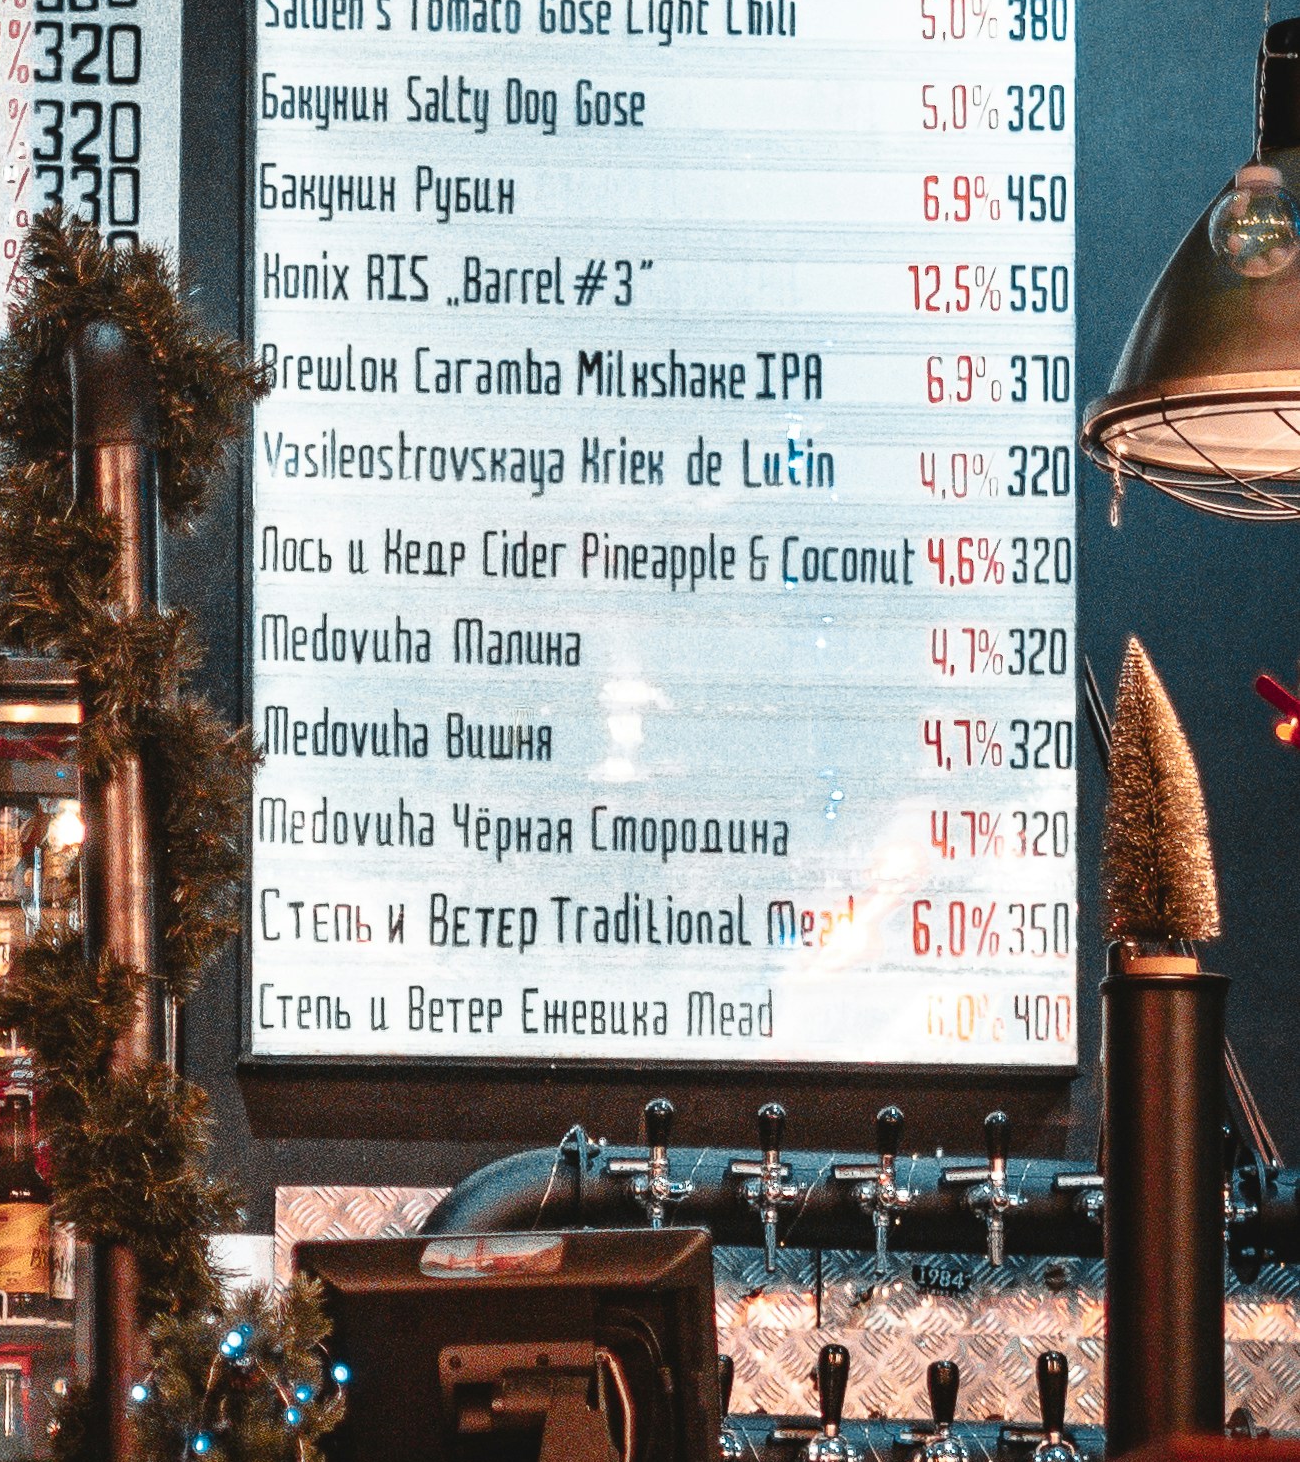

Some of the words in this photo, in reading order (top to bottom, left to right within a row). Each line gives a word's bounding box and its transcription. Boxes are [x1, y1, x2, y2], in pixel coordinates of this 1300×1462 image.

[33, 20, 142, 86] 320
[33, 99, 142, 164] 320
[262, 75, 388, 131] Бакунин
[407, 75, 489, 134] Salty
[505, 78, 558, 136] Dog
[575, 79, 646, 128] Gose
[1006, 83, 1064, 133] 320
[262, 164, 396, 222] Бакунин
[415, 165, 515, 224] Рубин
[1007, 174, 1065, 222] 450
[266, 250, 349, 301] Konix
[367, 253, 429, 303] RIS
[1010, 264, 1066, 313] 550
[415, 346, 562, 396] Caramba
[577, 348, 746, 400] Milkshake
[756, 351, 822, 401] IPA
[1010, 354, 1068, 403] 370
[265, 429, 565, 498] Vasileostrovskaya
[581, 436, 664, 485] Kriek
[686, 435, 722, 487] de
[742, 438, 835, 488] Lutin
[1007, 445, 1068, 497] 320
[263, 526, 332, 573] Лось
[348, 539, 368, 574] и
[384, 528, 466, 577] Кедр
[482, 529, 567, 579] Cider
[582, 532, 736, 592] Pineapple
[782, 535, 915, 586] Coconut
[1011, 537, 1072, 585] 320
[266, 613, 431, 664] Medovuha
[454, 618, 582, 667] Малина
[1008, 628, 1065, 676] 320
[265, 706, 429, 759] Medovuha
[446, 712, 553, 761] Вишня
[1009, 719, 1074, 770] 320
[261, 796, 434, 847] Medovuha
[453, 803, 572, 863] Чёрная
[591, 806, 790, 863] Смородина
[1013, 811, 1066, 857] 320
[550, 892, 751, 947] Traditional
[1008, 903, 1068, 952] 350
[261, 984, 351, 1030] Степь
[370, 997, 387, 1031] и
[408, 985, 503, 1033] Ветер
[522, 987, 668, 1035] Ежевика
[688, 989, 773, 1037] Mead
[1014, 994, 1072, 1041] 400
